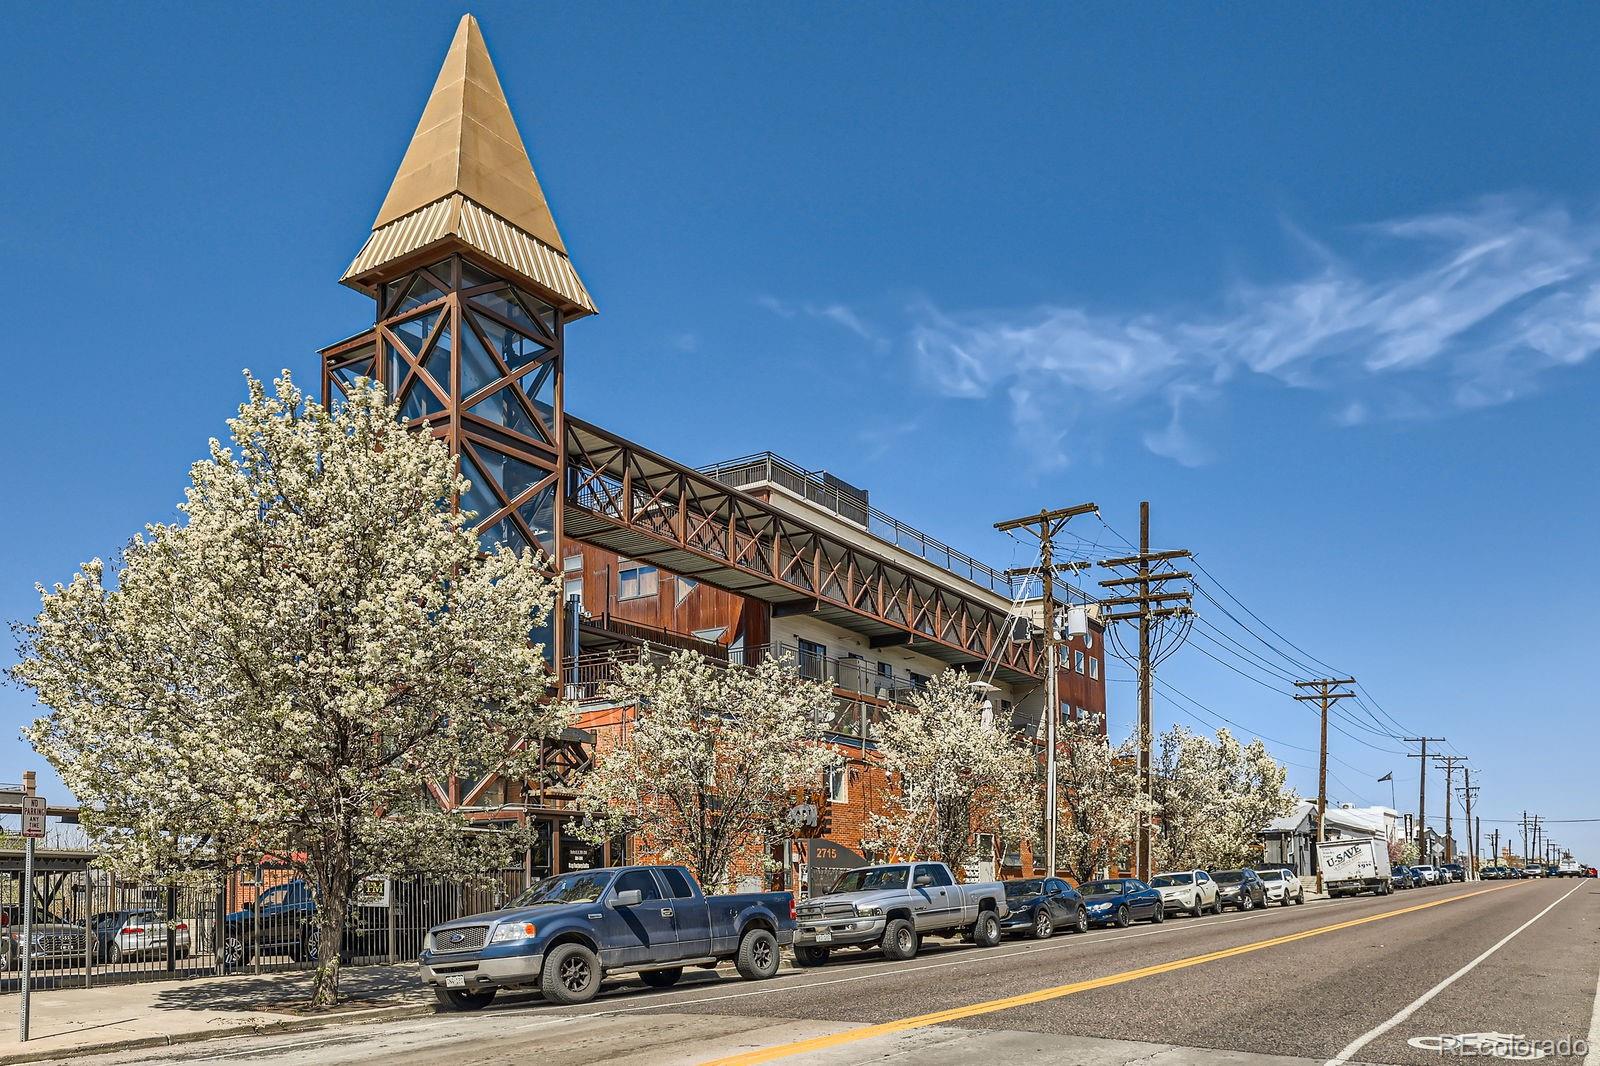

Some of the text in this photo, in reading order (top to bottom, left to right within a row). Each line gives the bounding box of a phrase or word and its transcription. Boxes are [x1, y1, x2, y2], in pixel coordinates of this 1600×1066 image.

[25, 807, 46, 816] PARKING
[816, 848, 837, 859] 2715
[1326, 844, 1362, 867] U-SAVE
